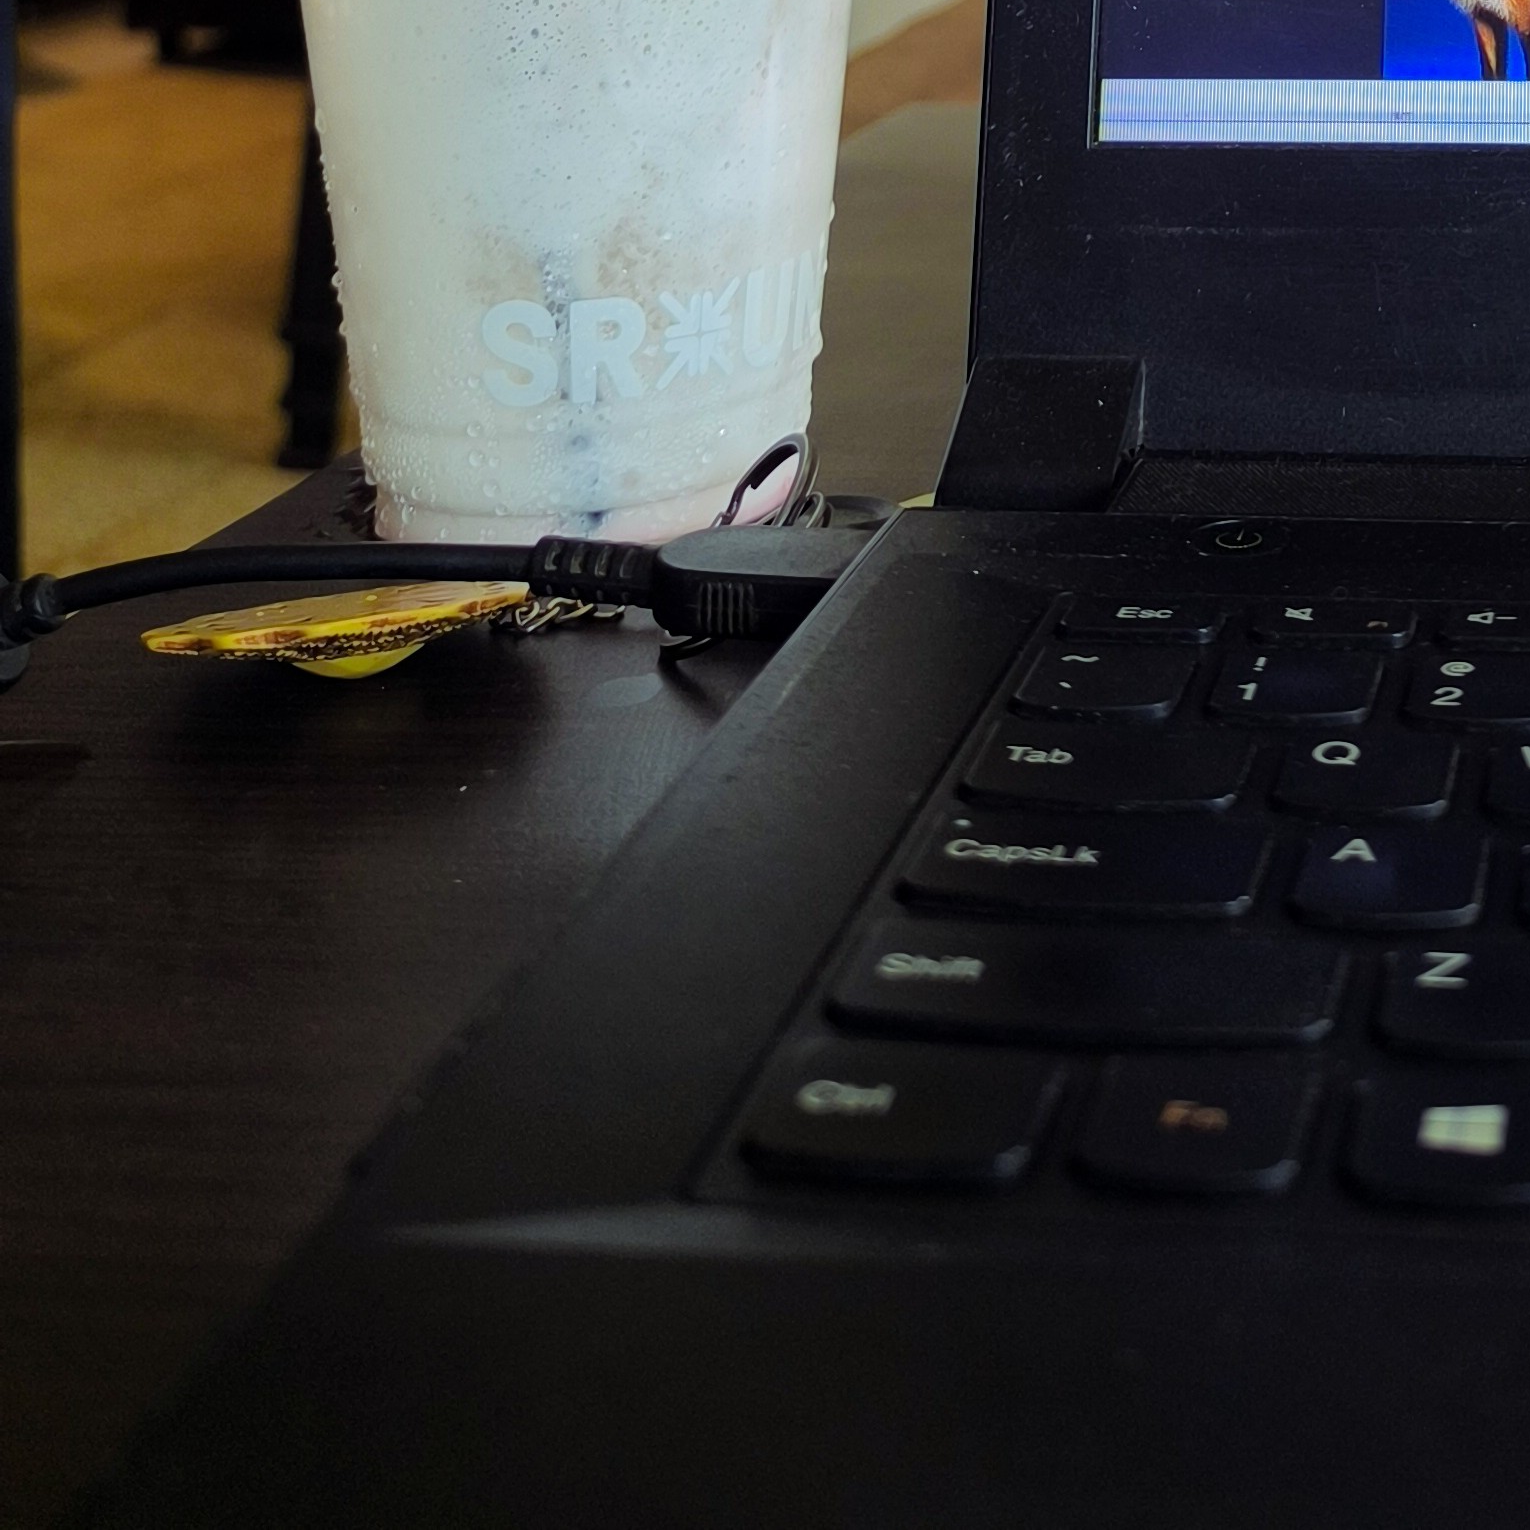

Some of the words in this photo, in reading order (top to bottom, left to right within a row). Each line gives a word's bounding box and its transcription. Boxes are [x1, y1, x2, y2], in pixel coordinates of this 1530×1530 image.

[1115, 606, 1174, 620] Esc
[1440, 661, 1476, 677] @
[1238, 681, 1259, 701] 1
[1431, 686, 1465, 706] 2
[1006, 745, 1075, 766] Tab
[1311, 740, 1362, 766] Q
[1329, 837, 1379, 863] A
[1415, 951, 1472, 989] Z
